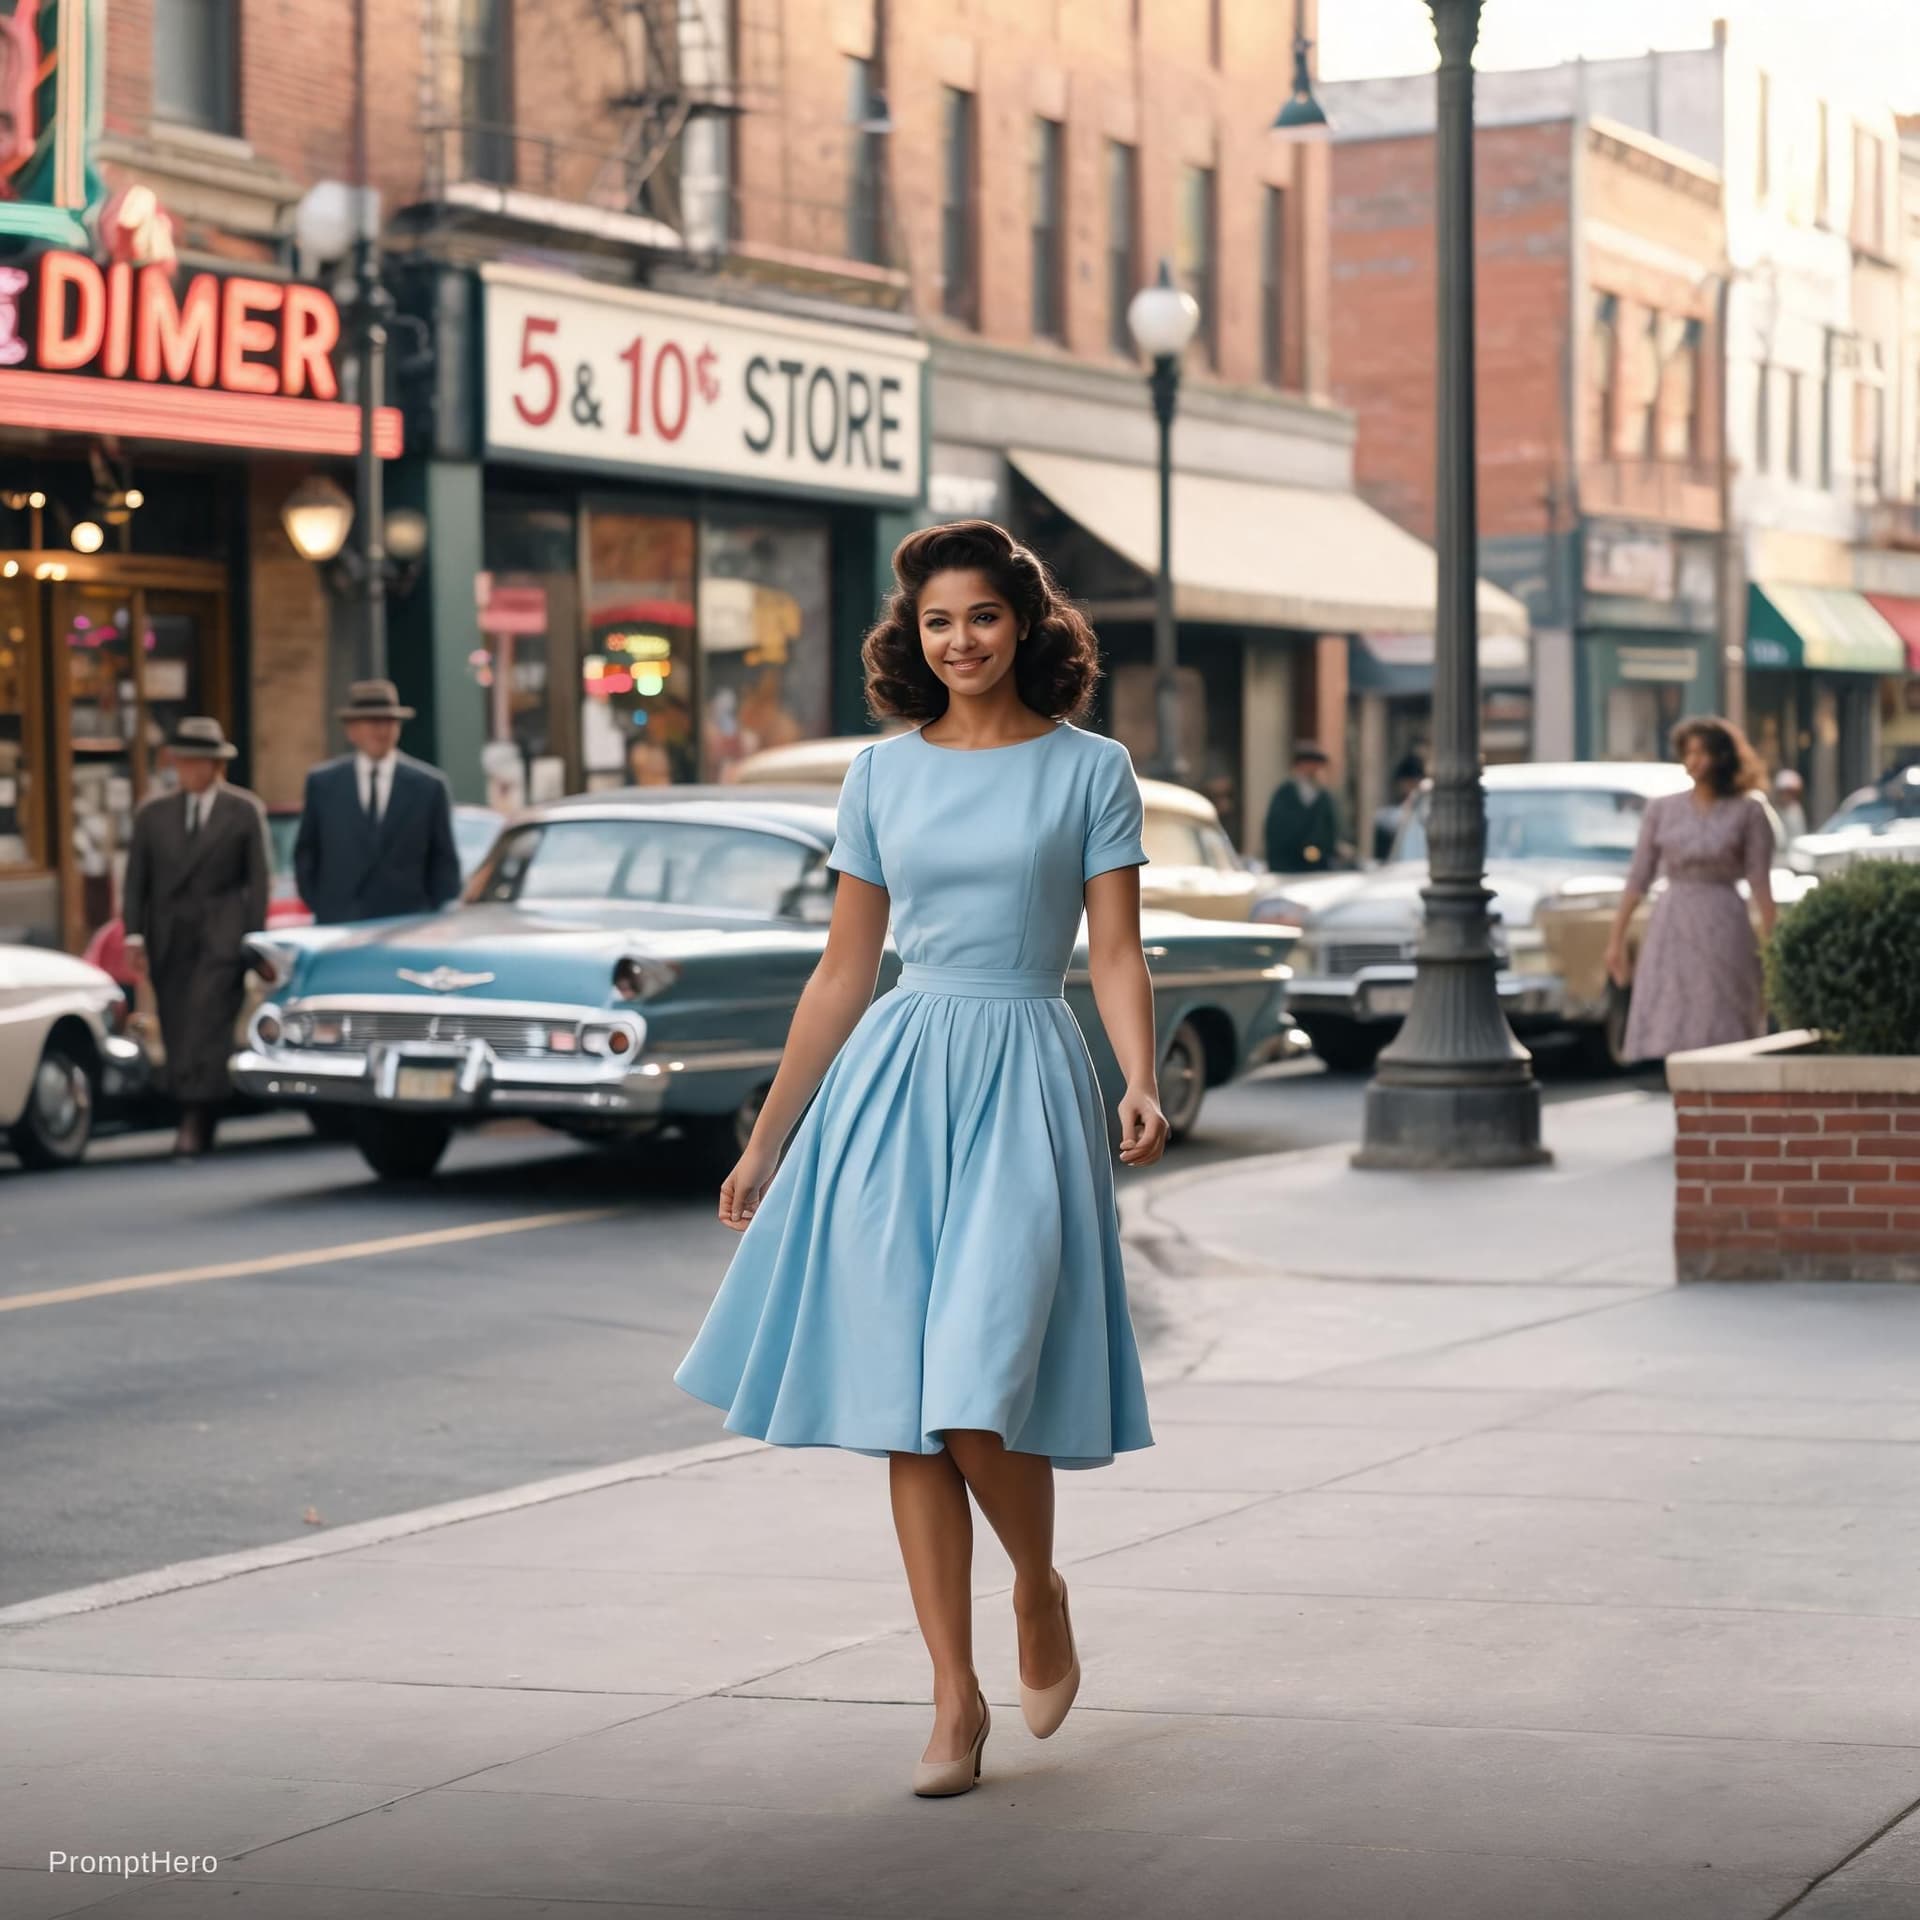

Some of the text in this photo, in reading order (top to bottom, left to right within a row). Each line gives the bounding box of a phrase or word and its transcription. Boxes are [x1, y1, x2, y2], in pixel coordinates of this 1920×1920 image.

[37, 250, 340, 400] DIMER
[512, 315, 560, 427] 5
[571, 361, 603, 429] &
[743, 355, 901, 472] STORE
